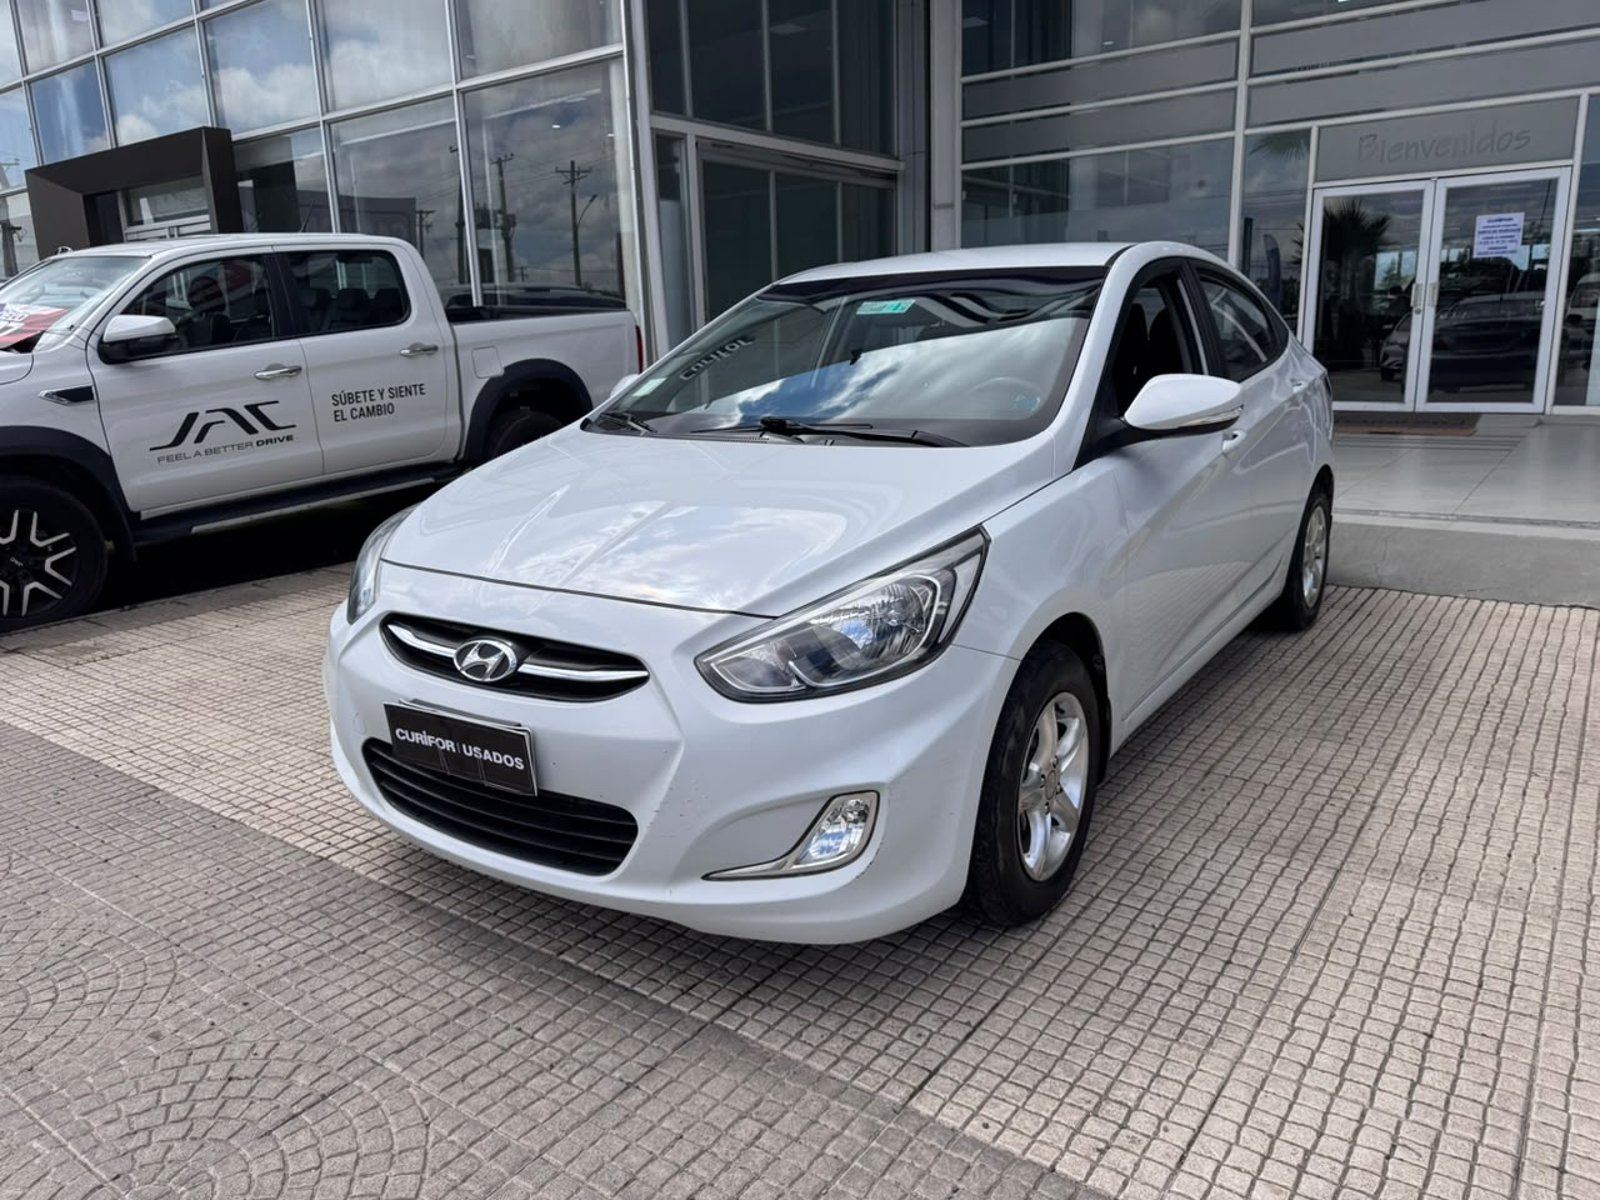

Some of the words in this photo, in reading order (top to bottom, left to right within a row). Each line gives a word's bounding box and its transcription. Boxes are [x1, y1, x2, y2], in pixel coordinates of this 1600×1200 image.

[1358, 121, 1531, 164] Bienvenidos
[331, 390, 376, 407] SÚBETE
[377, 387, 385, 400] Y
[388, 383, 426, 399] SIENTE
[149, 400, 297, 451] JAC
[333, 409, 347, 422] EL
[350, 402, 395, 420] CAMBIO
[157, 453, 191, 464] FEEL
[193, 450, 202, 458] A
[204, 441, 253, 457] BETTER
[256, 434, 294, 448] DRIVE
[462, 743, 525, 770] USADOS
